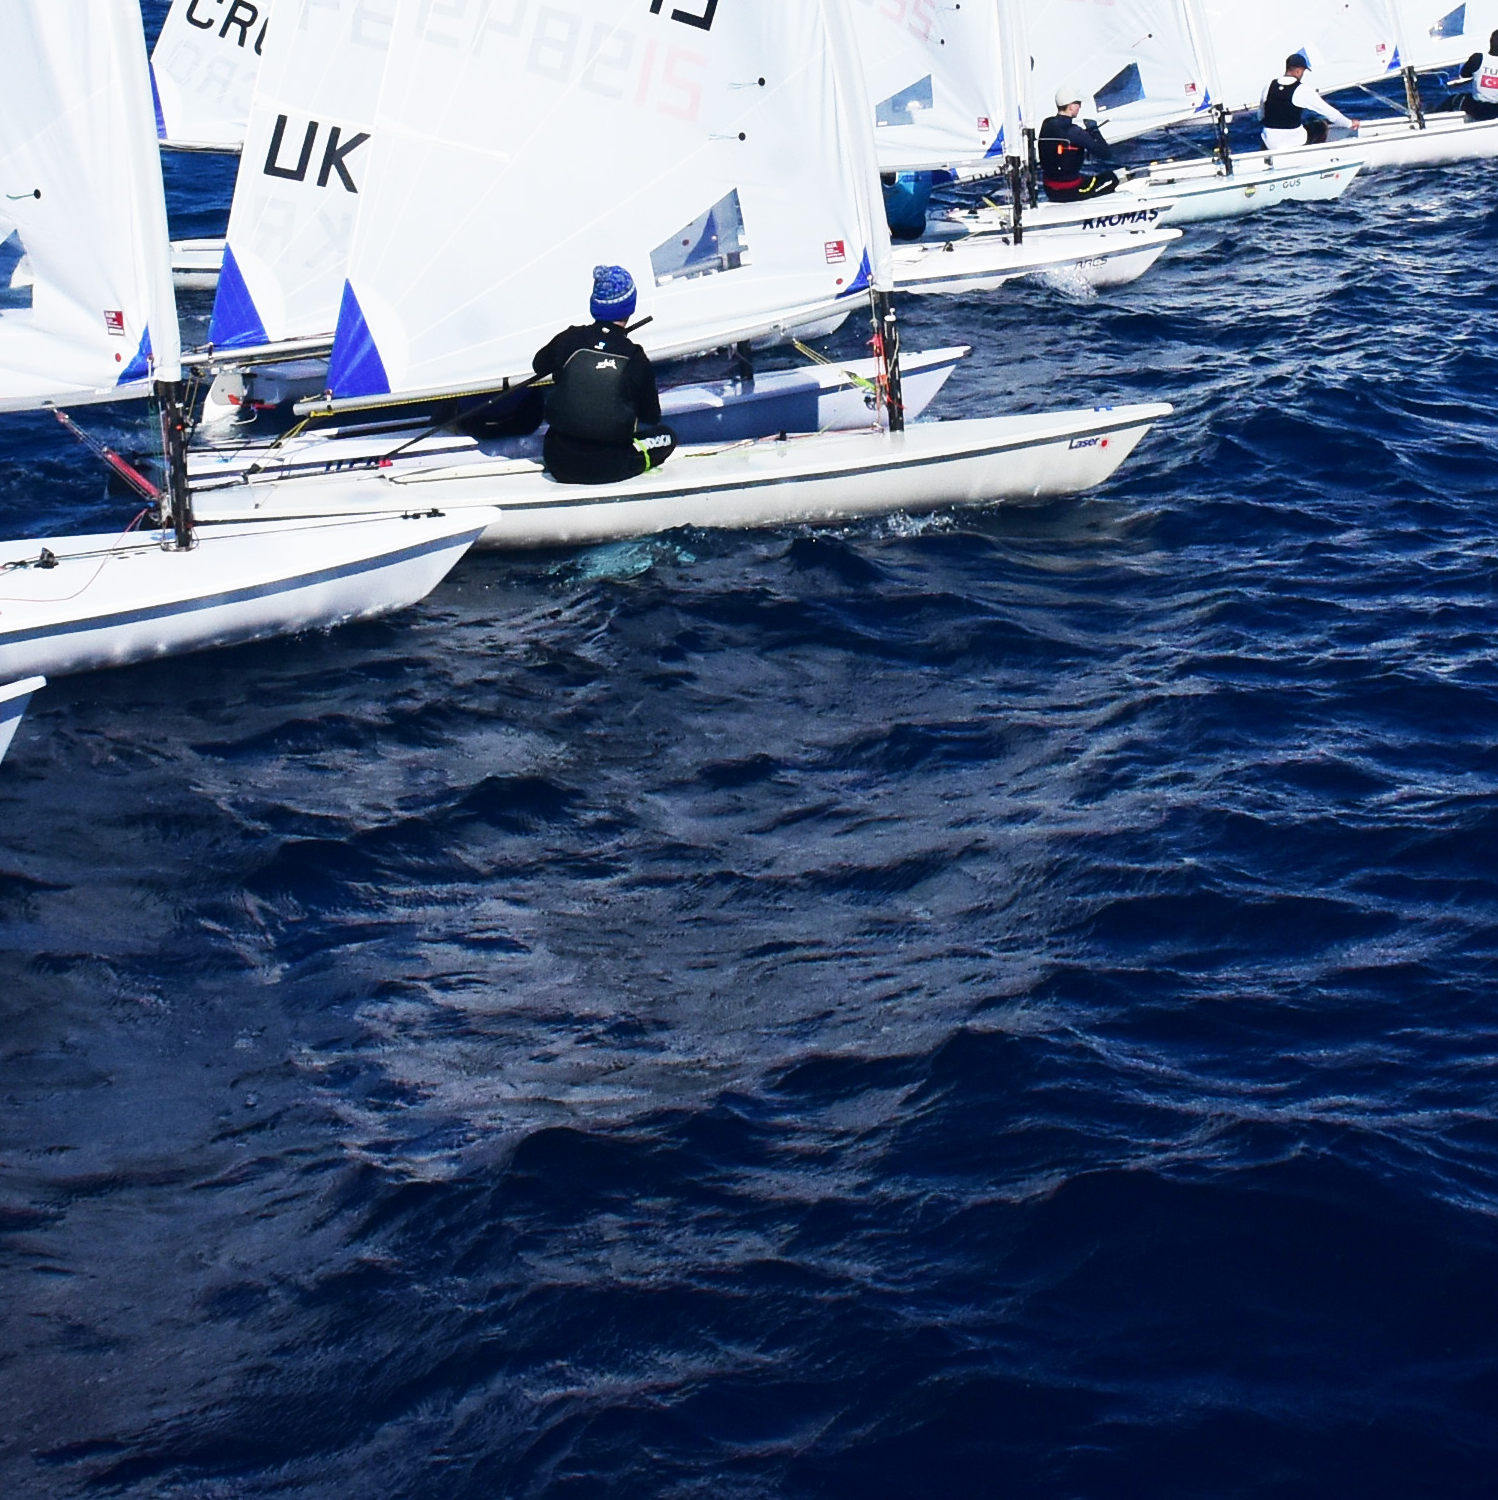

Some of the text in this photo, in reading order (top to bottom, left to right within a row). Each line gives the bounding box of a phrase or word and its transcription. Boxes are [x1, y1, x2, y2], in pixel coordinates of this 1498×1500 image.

[263, 113, 371, 194] UK
[1081, 208, 1159, 231] KROMAS
[1068, 436, 1101, 450] Laser
